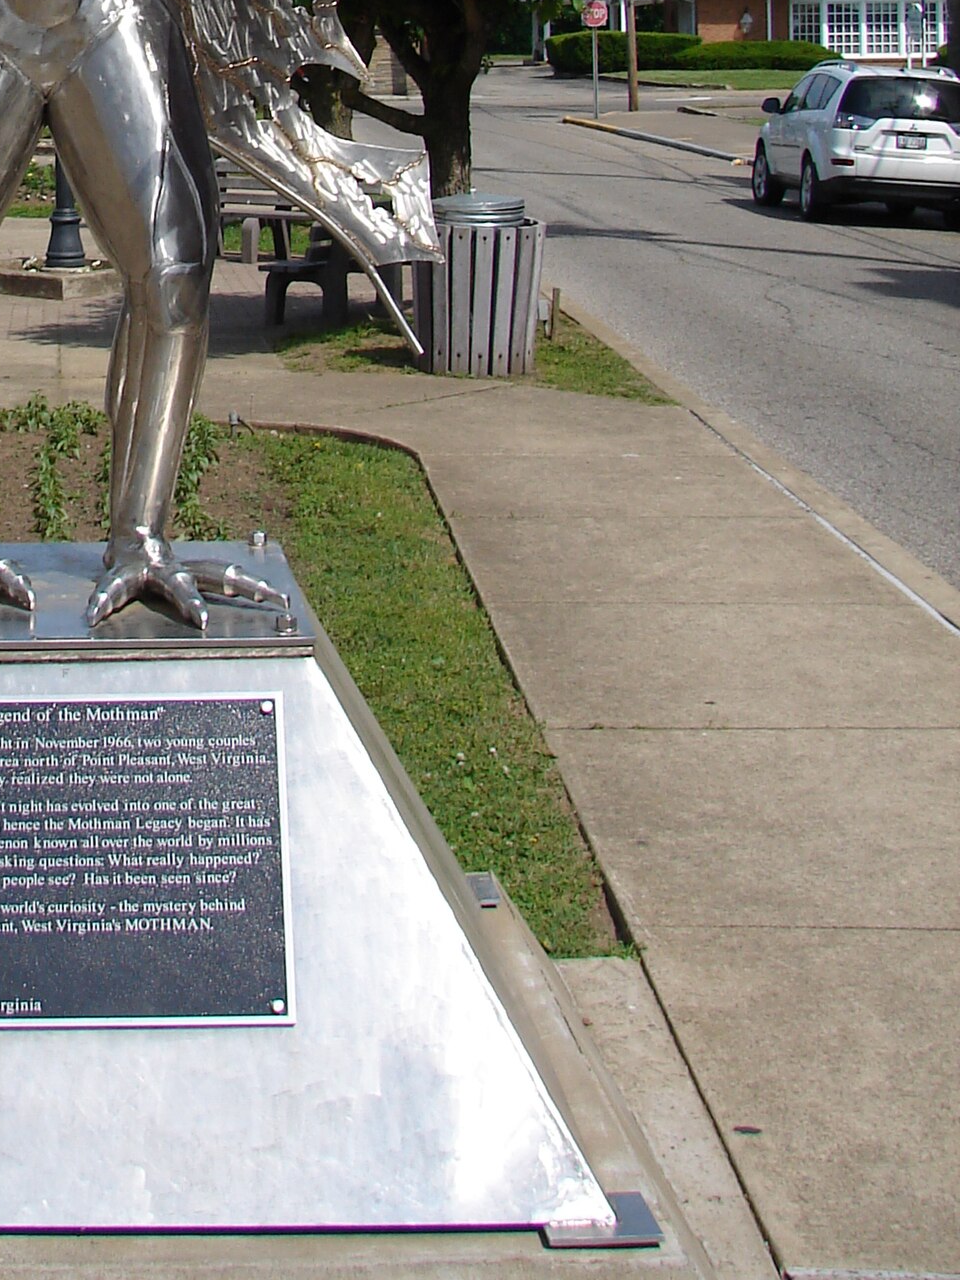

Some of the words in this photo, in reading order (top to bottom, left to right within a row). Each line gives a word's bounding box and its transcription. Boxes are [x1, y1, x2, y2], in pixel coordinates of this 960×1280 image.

[36, 709, 51, 722] of
[60, 709, 80, 720] the
[86, 707, 164, 720] Mothman"
[16, 737, 28, 748] in
[35, 736, 99, 748] November
[103, 736, 134, 749] 1966,
[138, 736, 161, 748] two
[166, 738, 204, 750] young
[208, 735, 256, 749] couples
[24, 756, 58, 767] north
[62, 755, 77, 767] of
[83, 754, 114, 766] Point
[118, 754, 175, 766] Pleasant,
[178, 753, 206, 765] West
[12, 773, 63, 785] realized
[69, 773, 96, 786] they
[100, 773, 129, 783] were
[134, 773, 154, 783] not
[157, 772, 192, 783] alone.
[10, 800, 42, 815] night
[46, 800, 68, 812] has
[71, 800, 118, 812] evolved
[124, 800, 149, 811] into
[154, 801, 176, 811] one
[180, 799, 193, 810] of
[199, 798, 218, 810] the
[222, 799, 256, 812] great
[3, 819, 40, 831] hence
[44, 819, 64, 831] the
[68, 818, 130, 830] Mothman
[136, 818, 182, 831] Legacy
[188, 817, 231, 831] began.
[235, 816, 244, 827] It
[248, 816, 271, 828] has
[34, 837, 78, 849] known
[82, 836, 98, 848] all
[102, 837, 129, 848] over
[133, 835, 152, 847] the
[157, 835, 191, 847] world
[198, 835, 213, 848] by
[218, 834, 272, 847] millions
[108, 854, 143, 866] What
[146, 853, 184, 867] really
[190, 852, 259, 866] happened?
[3, 874, 45, 888] people
[48, 873, 76, 886] see?
[84, 873, 109, 885] Has
[112, 873, 121, 885] it
[125, 873, 156, 885] been
[161, 874, 190, 884] seen
[195, 871, 236, 883] since?
[1, 901, 44, 913] world's
[47, 900, 105, 915] curiosity
[119, 900, 138, 912] the
[143, 901, 196, 914] mystery
[200, 899, 245, 911] behind
[22, 920, 52, 932] West
[56, 919, 121, 934] Virginia's
[126, 918, 213, 930] MOTHMAN.
